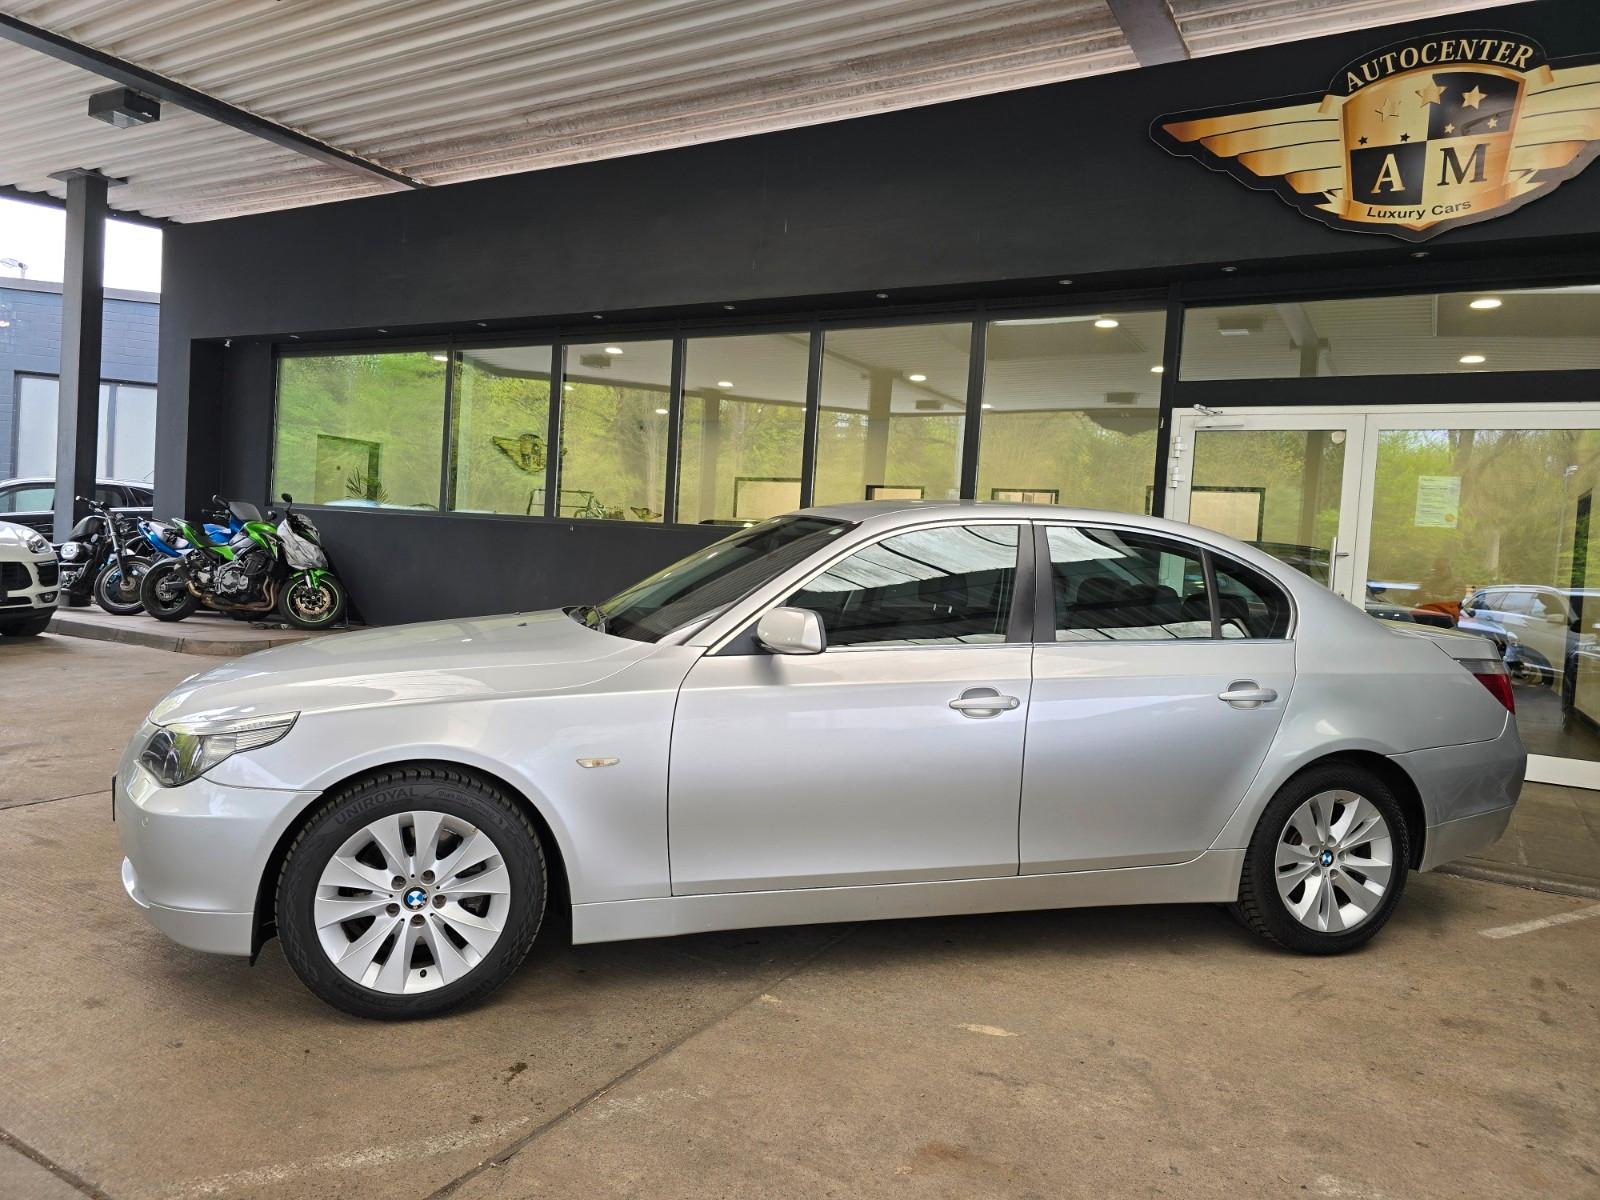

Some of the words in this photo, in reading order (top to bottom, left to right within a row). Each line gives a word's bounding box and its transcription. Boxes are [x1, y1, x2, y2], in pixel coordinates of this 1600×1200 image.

[1346, 40, 1534, 93] AUTOCENTER
[1370, 153, 1405, 193] A
[1437, 143, 1490, 186] M
[1366, 206, 1426, 220] Luxury
[1431, 199, 1472, 216] Cars
[336, 786, 419, 825] UNIROYAL
